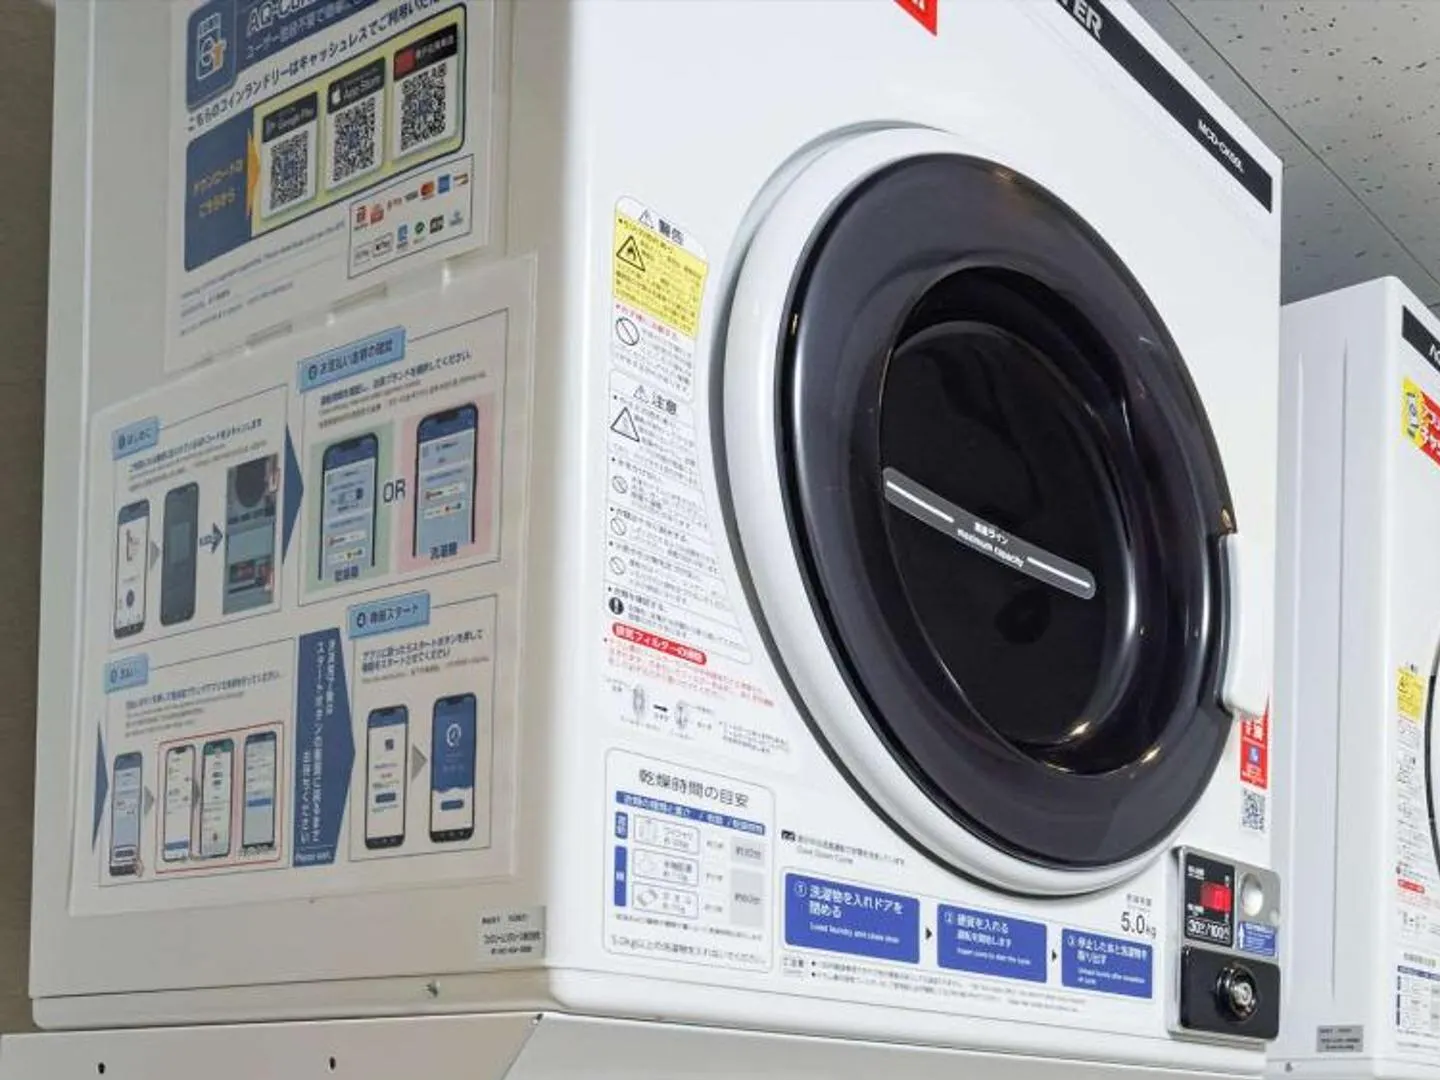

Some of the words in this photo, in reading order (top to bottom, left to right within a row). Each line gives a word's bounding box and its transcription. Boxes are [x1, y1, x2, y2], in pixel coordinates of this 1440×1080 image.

[382, 479, 406, 504] OR
[638, 768, 750, 809] 乾燥時間の目安
[809, 884, 904, 915] 洗濯物を入れドアを
